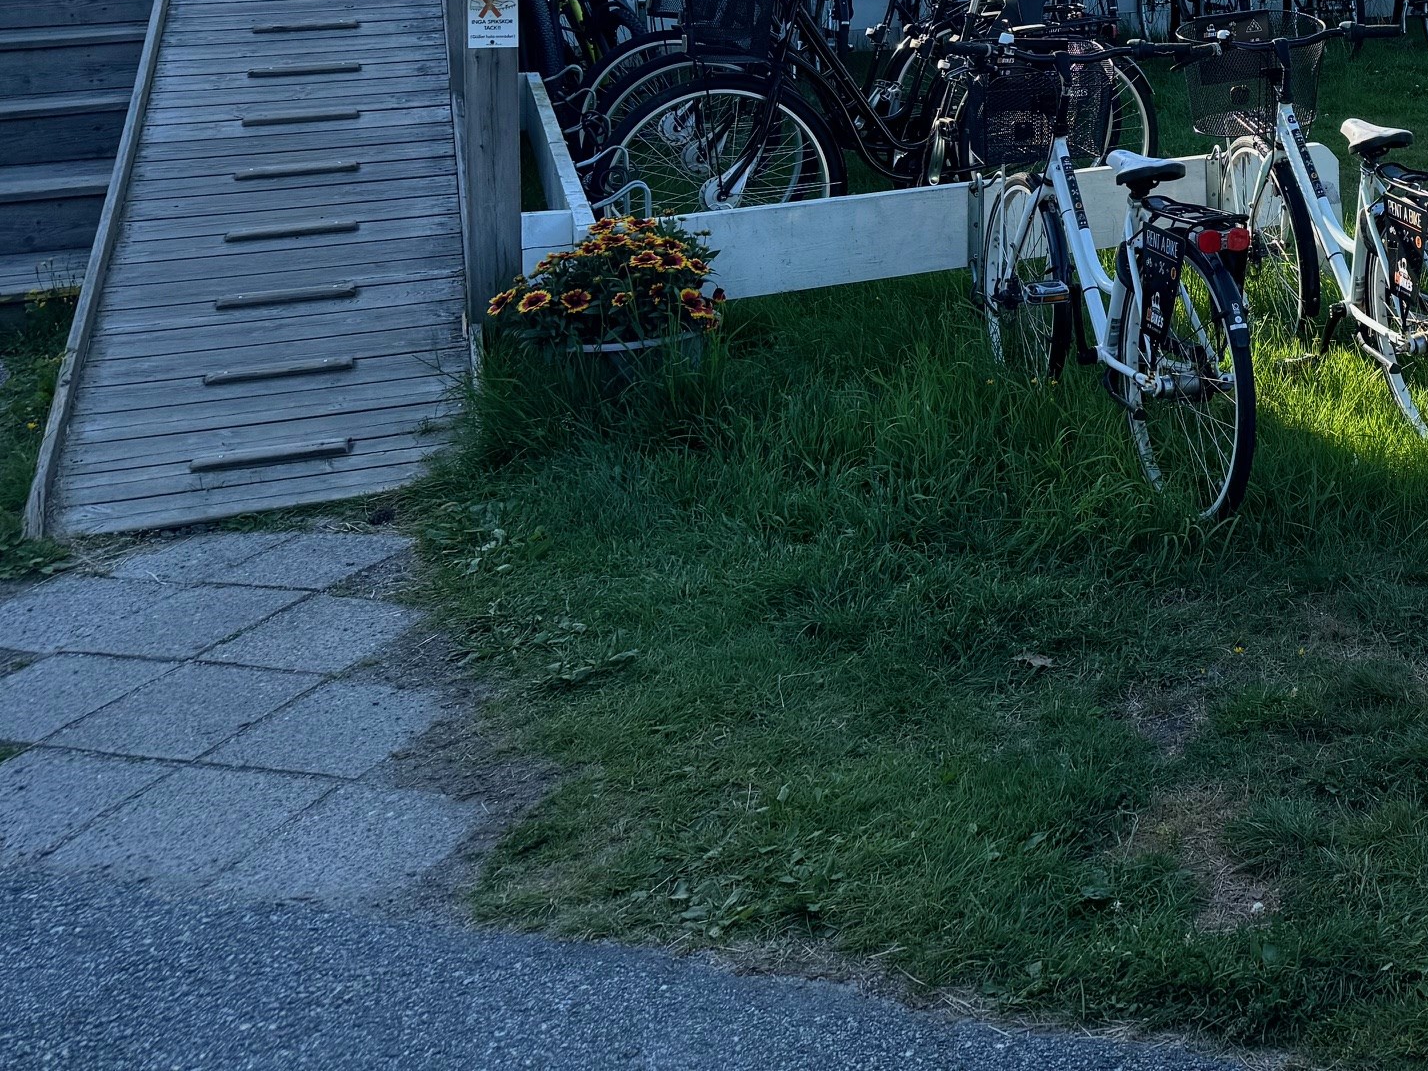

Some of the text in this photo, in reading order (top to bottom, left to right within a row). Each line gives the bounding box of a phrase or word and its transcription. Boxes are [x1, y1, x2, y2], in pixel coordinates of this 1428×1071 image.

[1387, 199, 1422, 229] RENT A BIKE
[1146, 229, 1179, 259] RENT A BIKE
